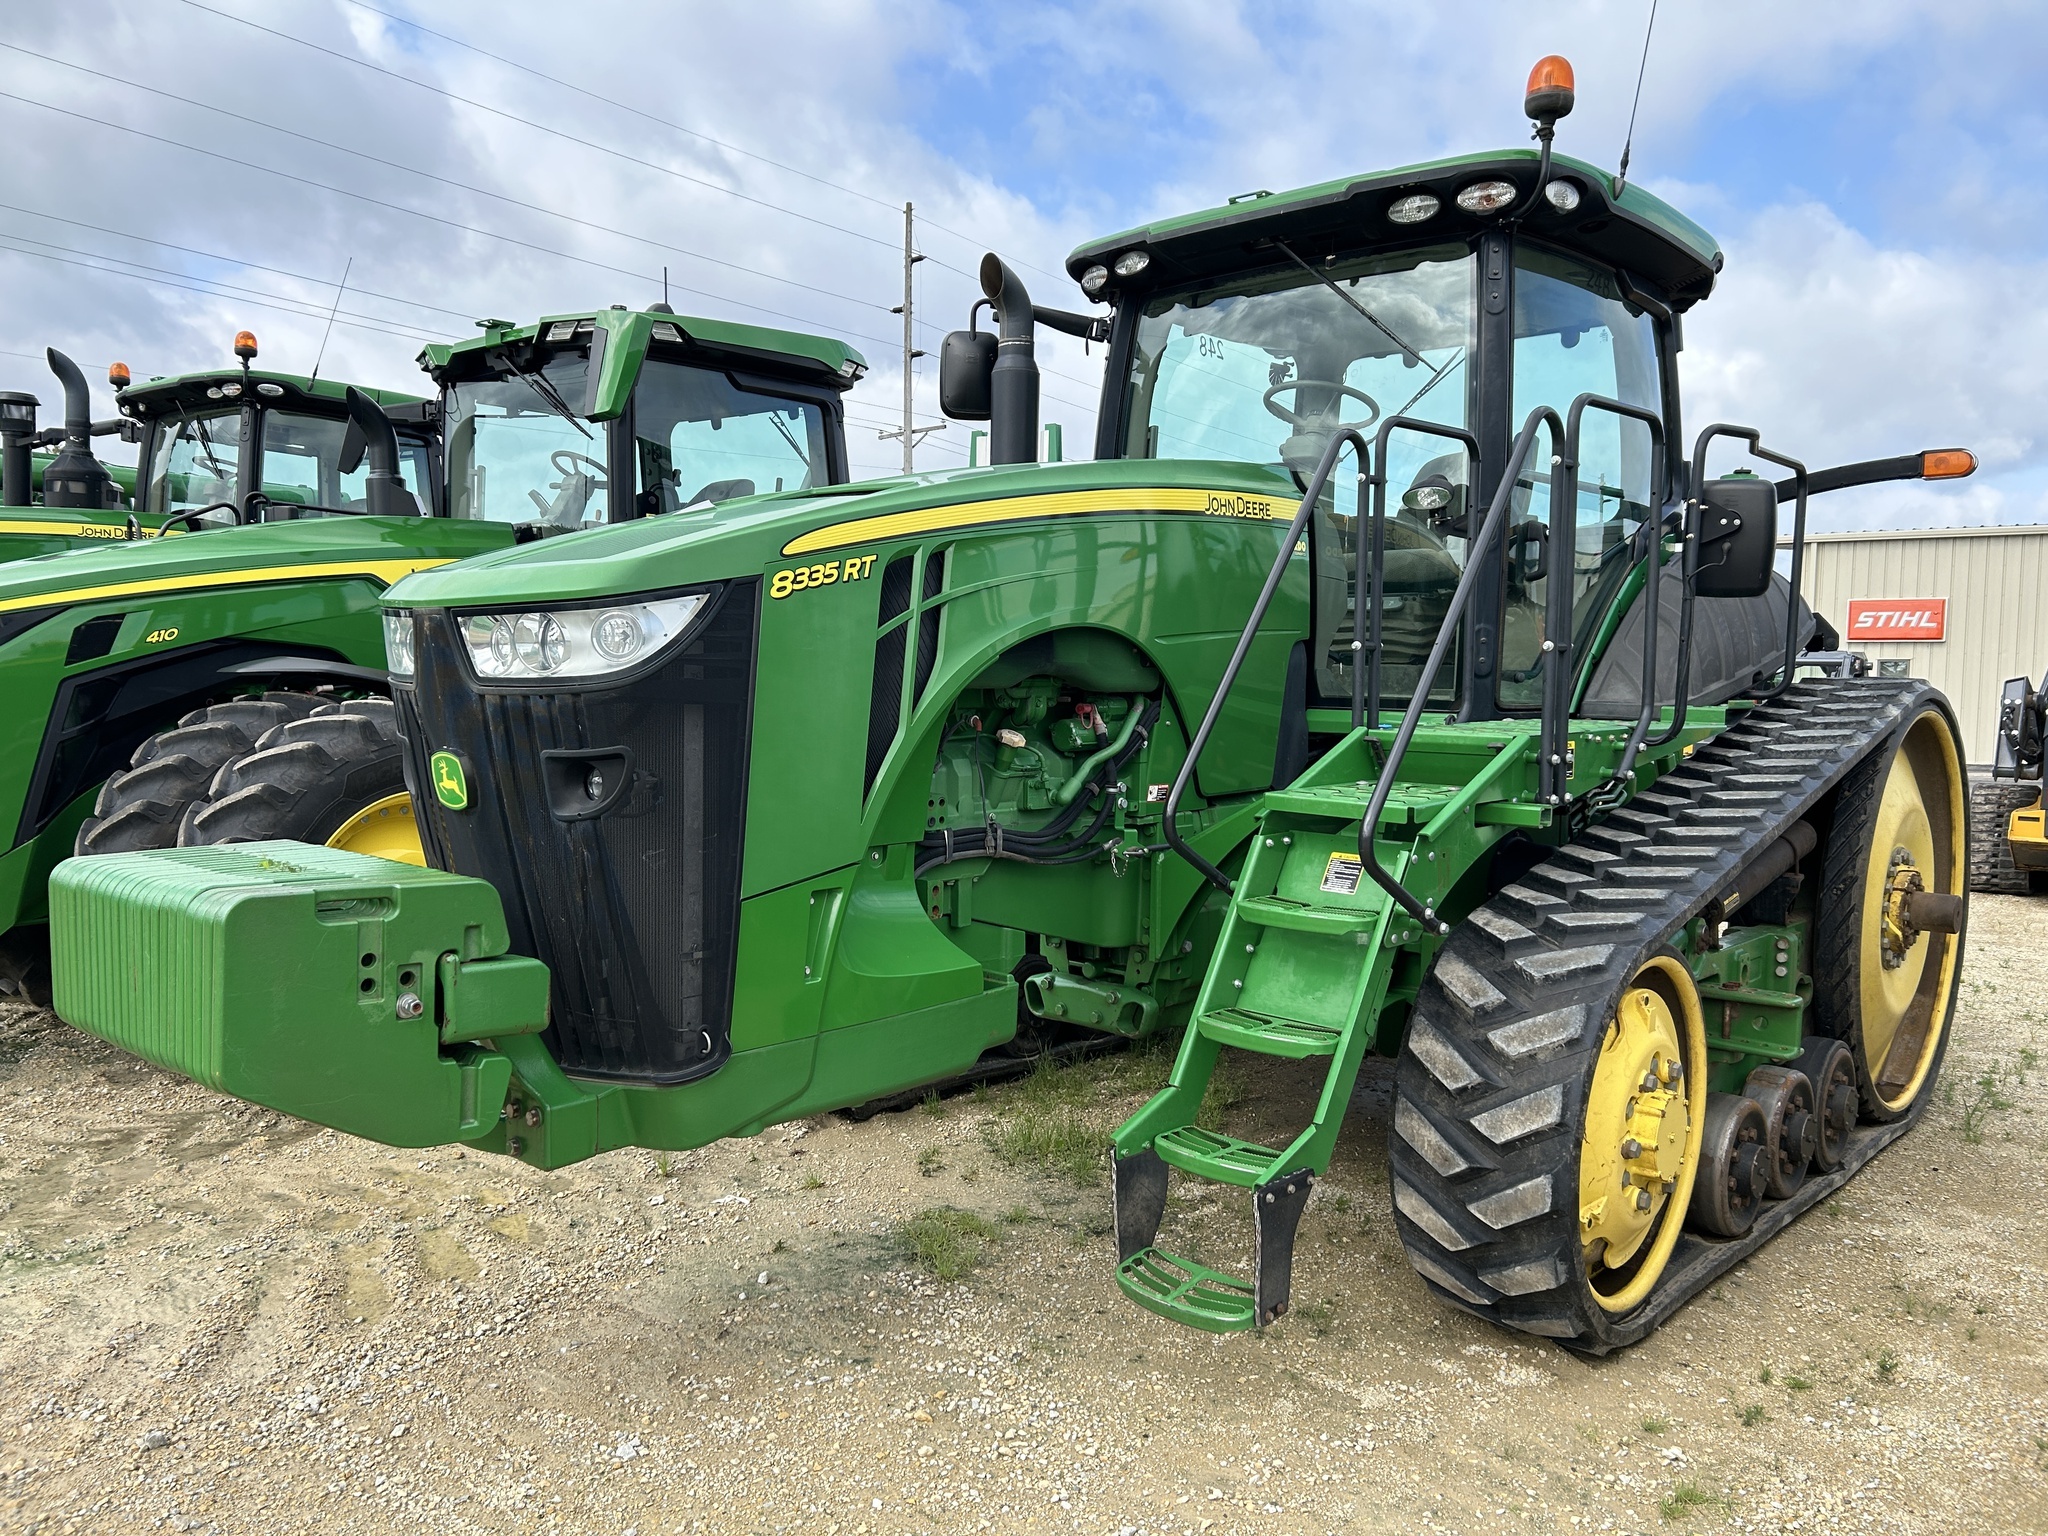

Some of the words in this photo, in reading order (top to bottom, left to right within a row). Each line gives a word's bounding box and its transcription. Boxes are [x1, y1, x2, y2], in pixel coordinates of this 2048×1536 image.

[1204, 493, 1236, 515] JOHN
[1236, 496, 1272, 519] DEERE
[78, 525, 112, 538] JOHN
[770, 561, 841, 599] 8335
[842, 553, 878, 583] RT
[1853, 611, 1938, 629] STIHL
[145, 627, 179, 644] 410
